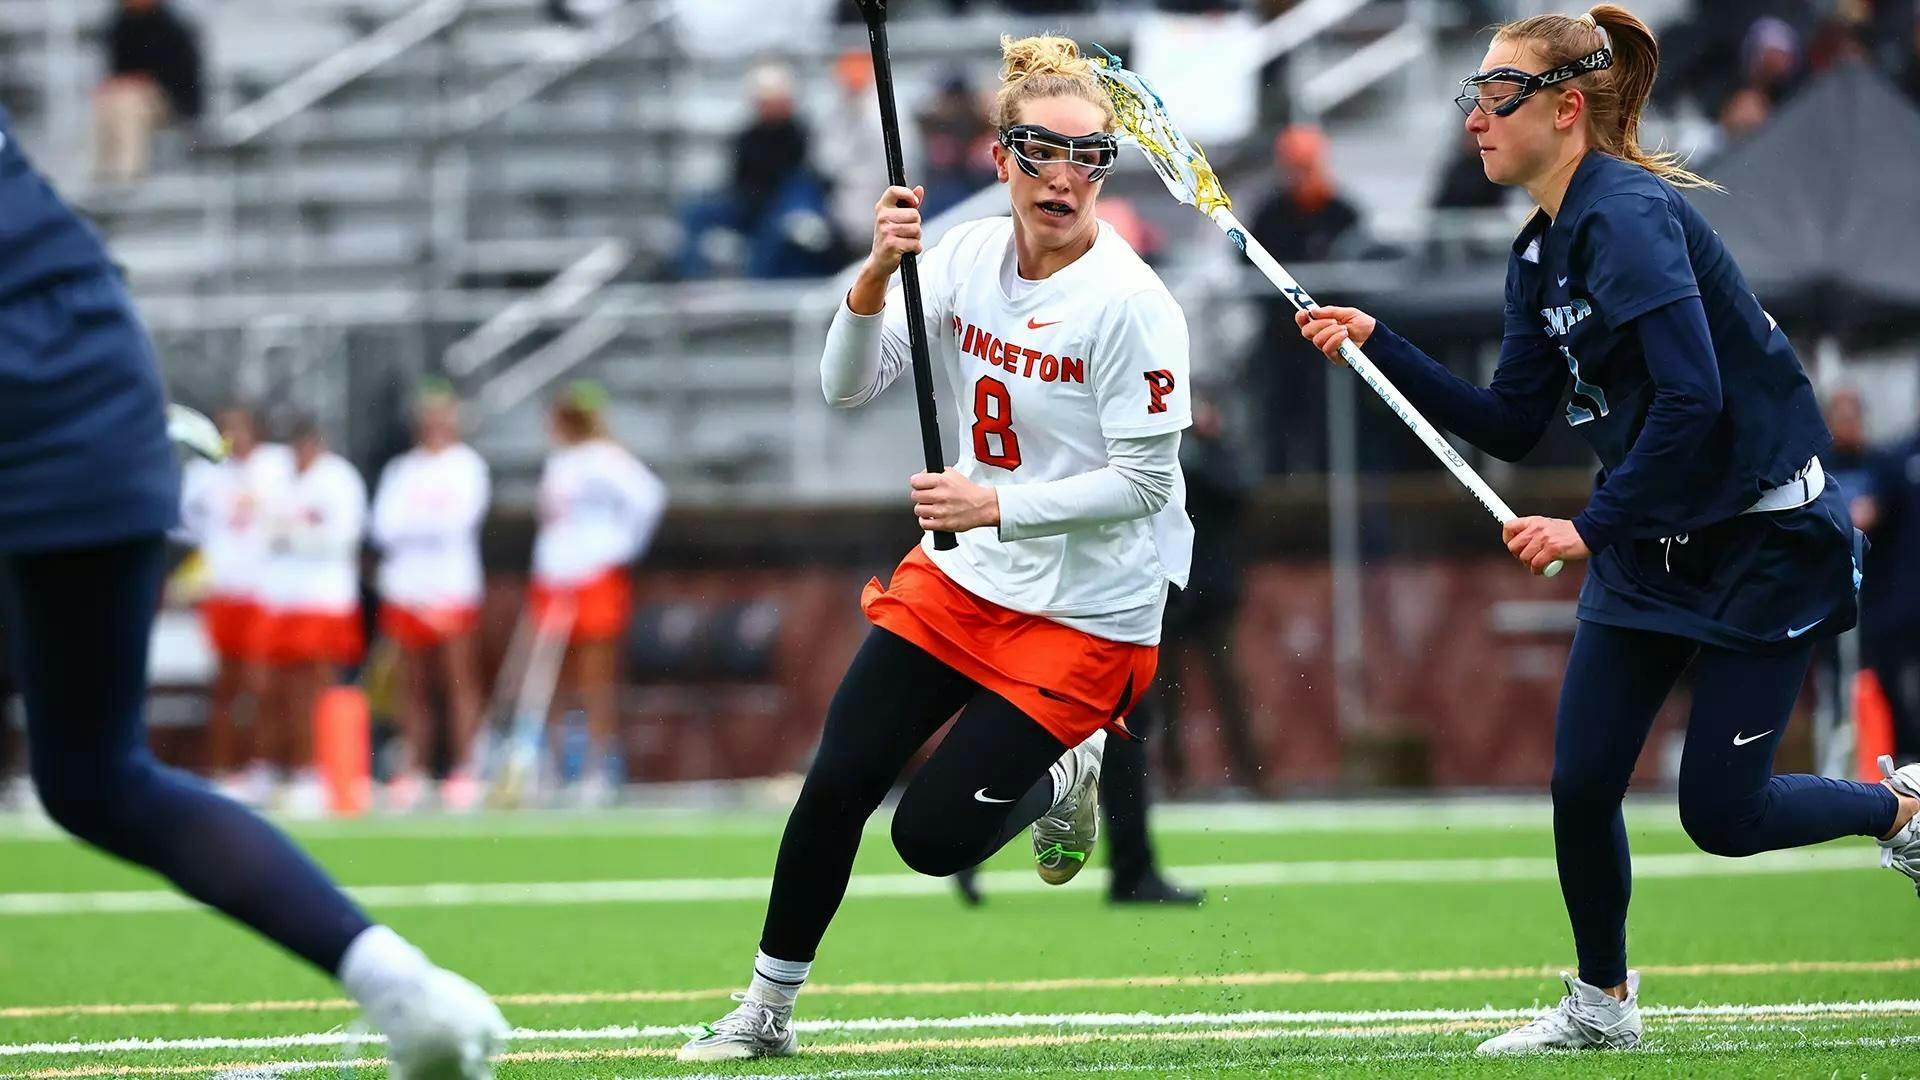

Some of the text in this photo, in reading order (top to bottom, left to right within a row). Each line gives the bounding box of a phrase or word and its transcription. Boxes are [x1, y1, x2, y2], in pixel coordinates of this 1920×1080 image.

[1538, 69, 1574, 87] STX
[1143, 368, 1175, 414] P
[972, 374, 1022, 472] 8
